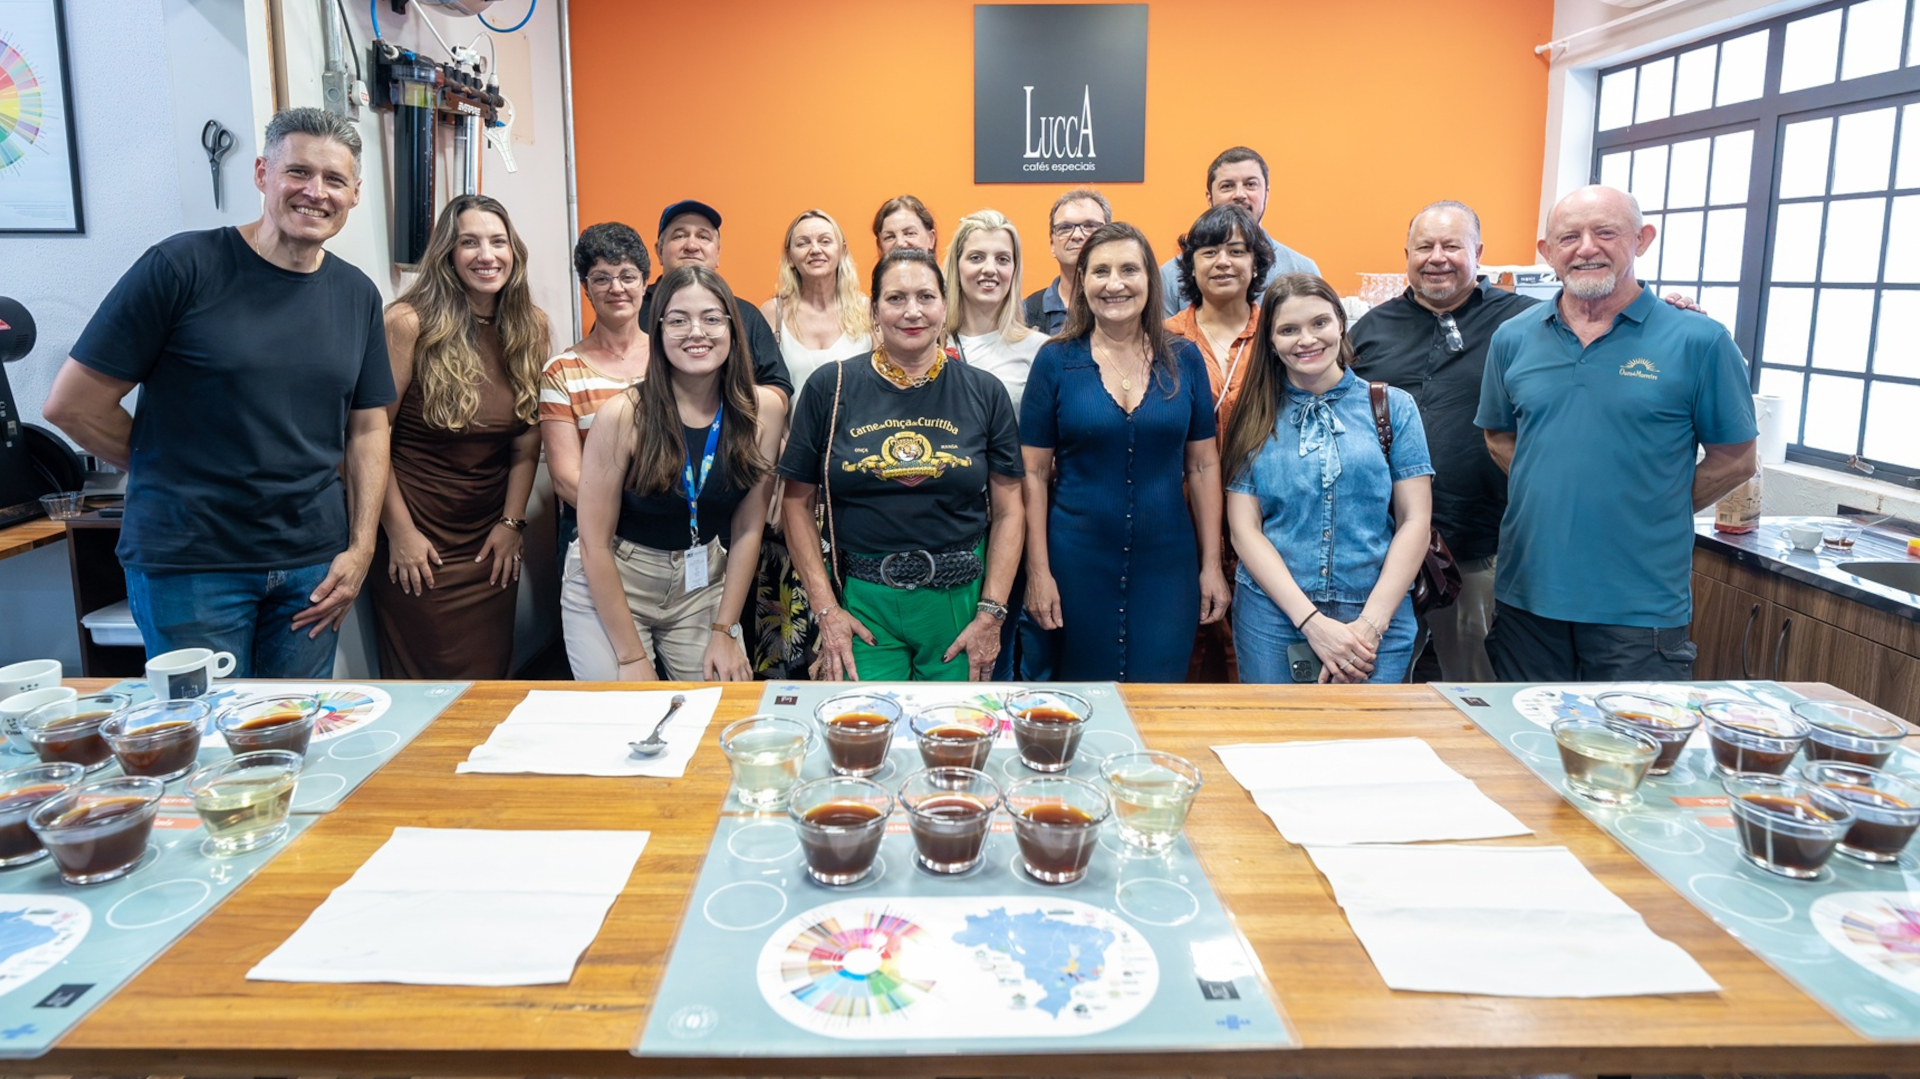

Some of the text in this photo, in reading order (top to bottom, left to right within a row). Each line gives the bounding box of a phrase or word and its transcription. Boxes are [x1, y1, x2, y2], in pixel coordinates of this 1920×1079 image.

[1022, 161, 1096, 173] cafés especiais
[850, 422, 878, 438] Carne
[884, 418, 912, 429] Onça
[917, 416, 959, 436] Curitiba
